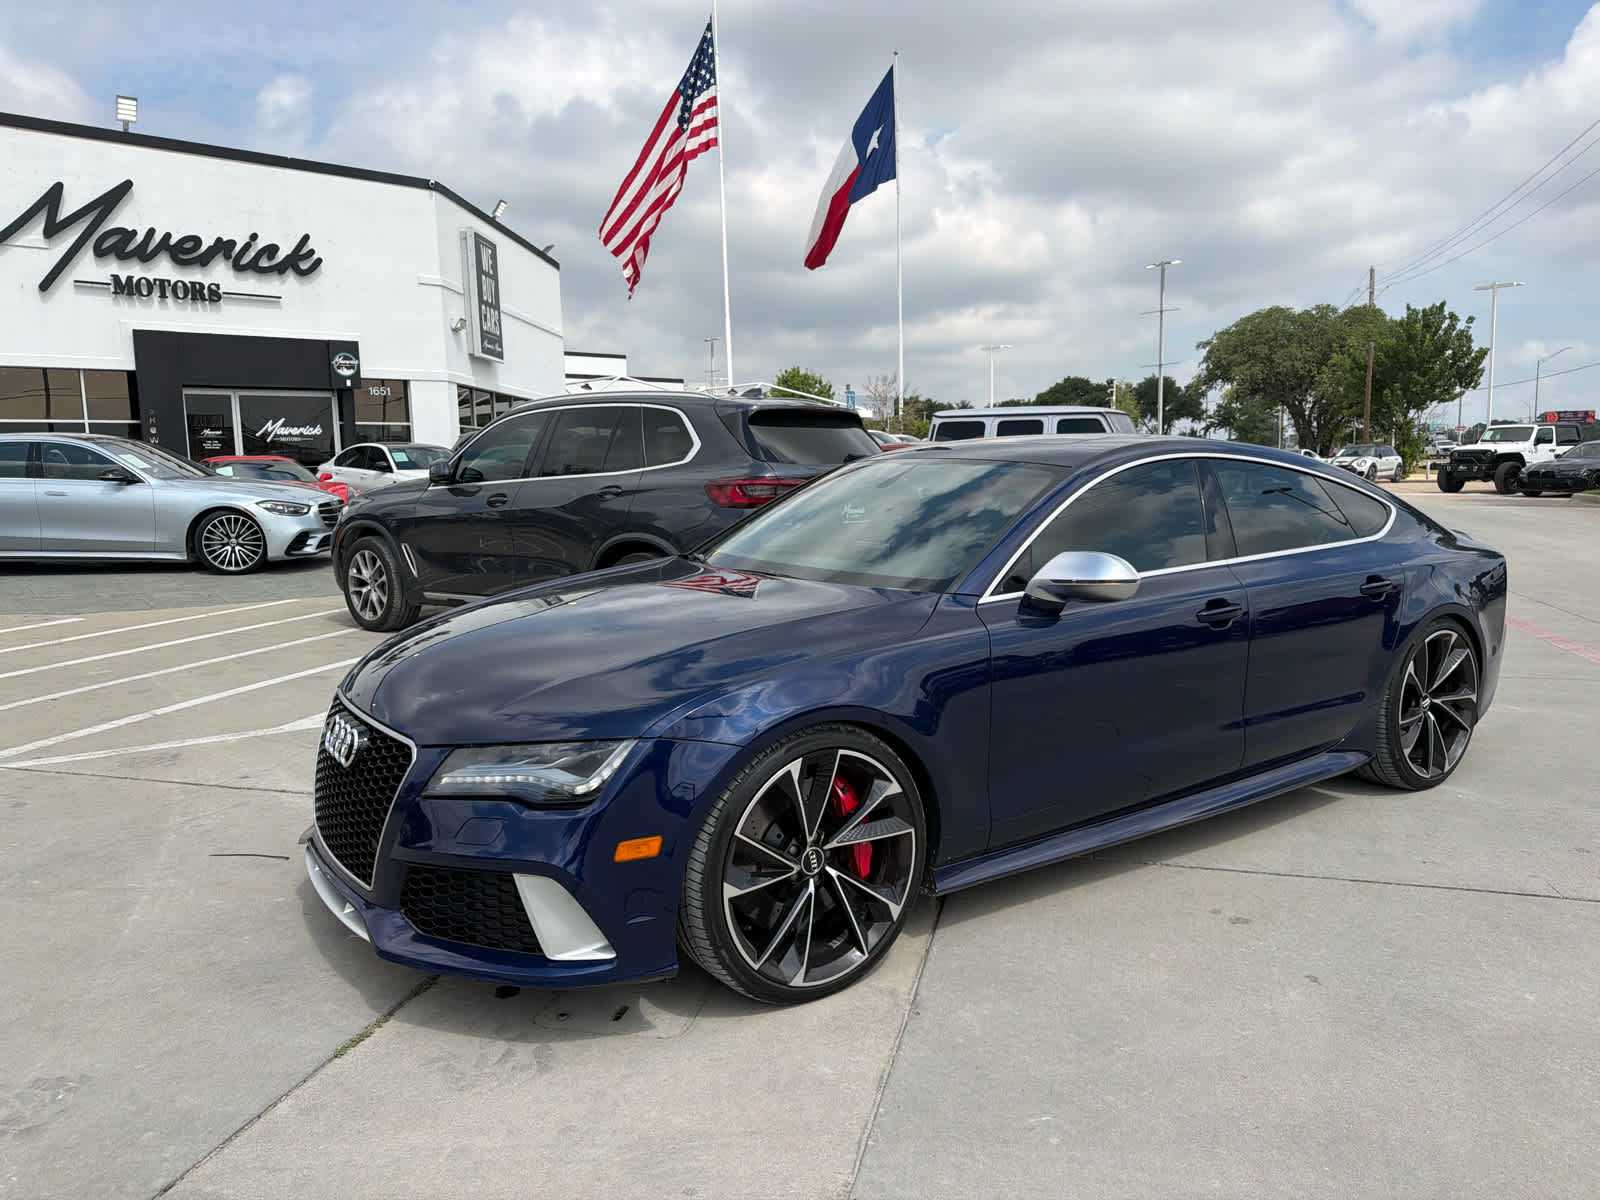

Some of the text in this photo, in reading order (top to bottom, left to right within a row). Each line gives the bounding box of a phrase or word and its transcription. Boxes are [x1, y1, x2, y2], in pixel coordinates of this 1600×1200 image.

[0, 179, 322, 291] Maverick
[110, 274, 222, 302] MOTORS
[482, 275, 496, 304] BUY
[482, 304, 500, 336] CARS
[368, 387, 390, 395] 1651
[256, 417, 322, 443] Maverick
